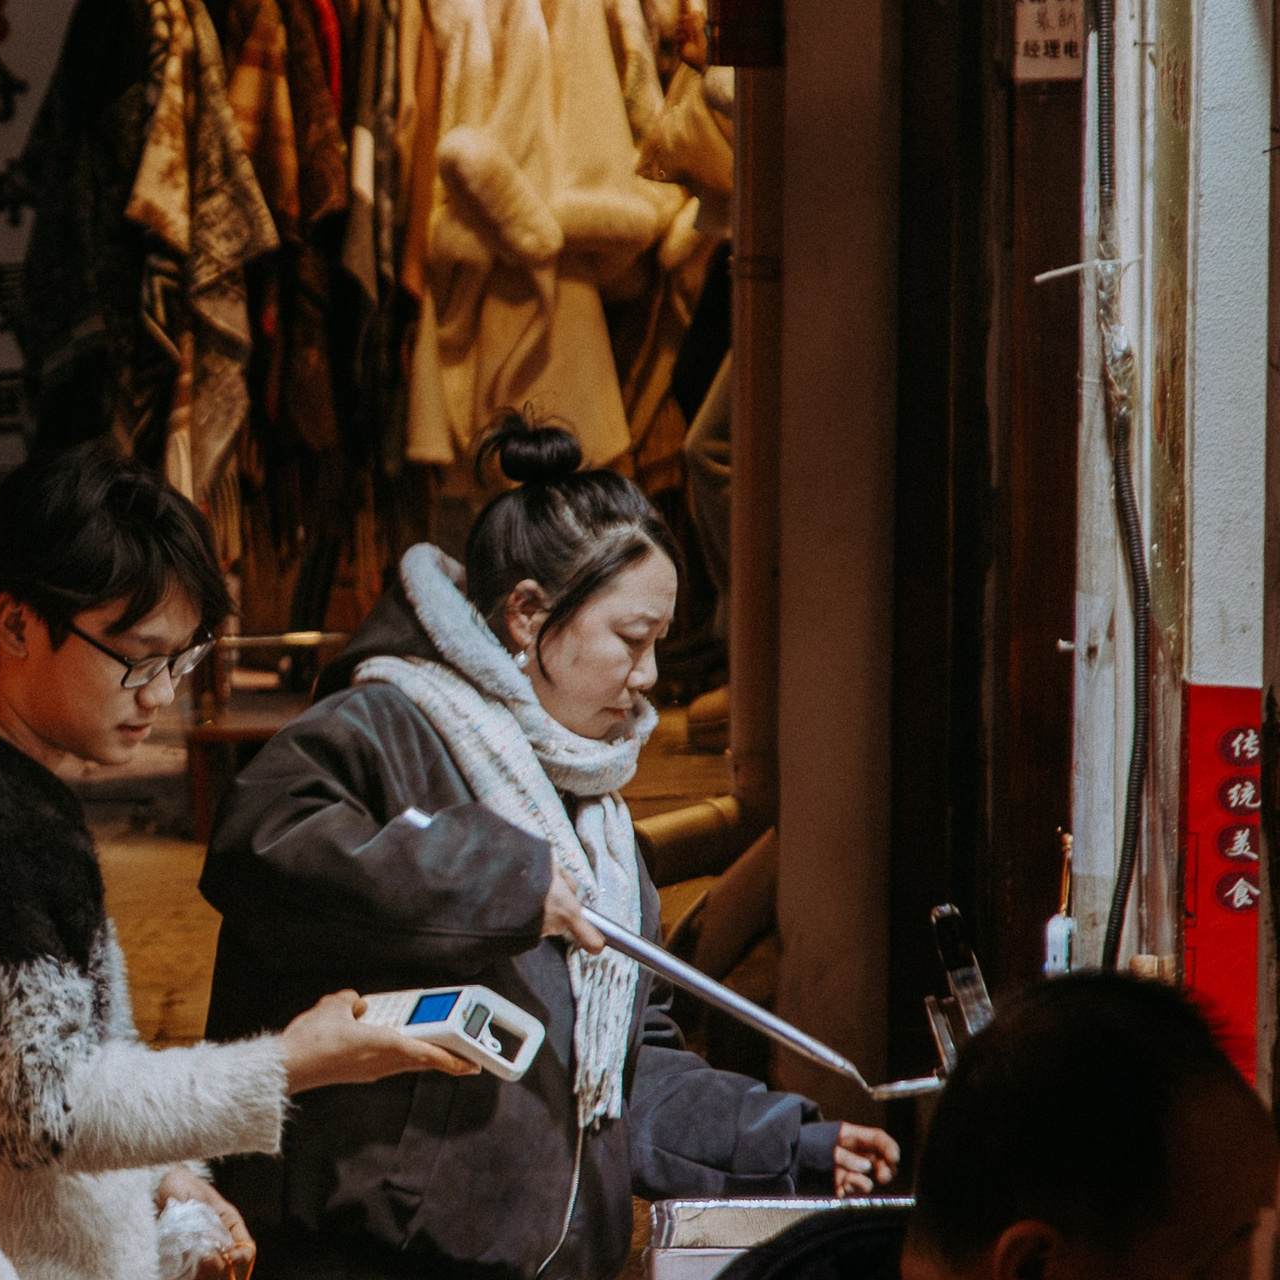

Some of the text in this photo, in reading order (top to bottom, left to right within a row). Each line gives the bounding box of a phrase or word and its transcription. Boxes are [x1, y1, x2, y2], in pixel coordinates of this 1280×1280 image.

[1015, 38, 1081, 59] 经理电
[1225, 729, 1261, 907] 传统美食
